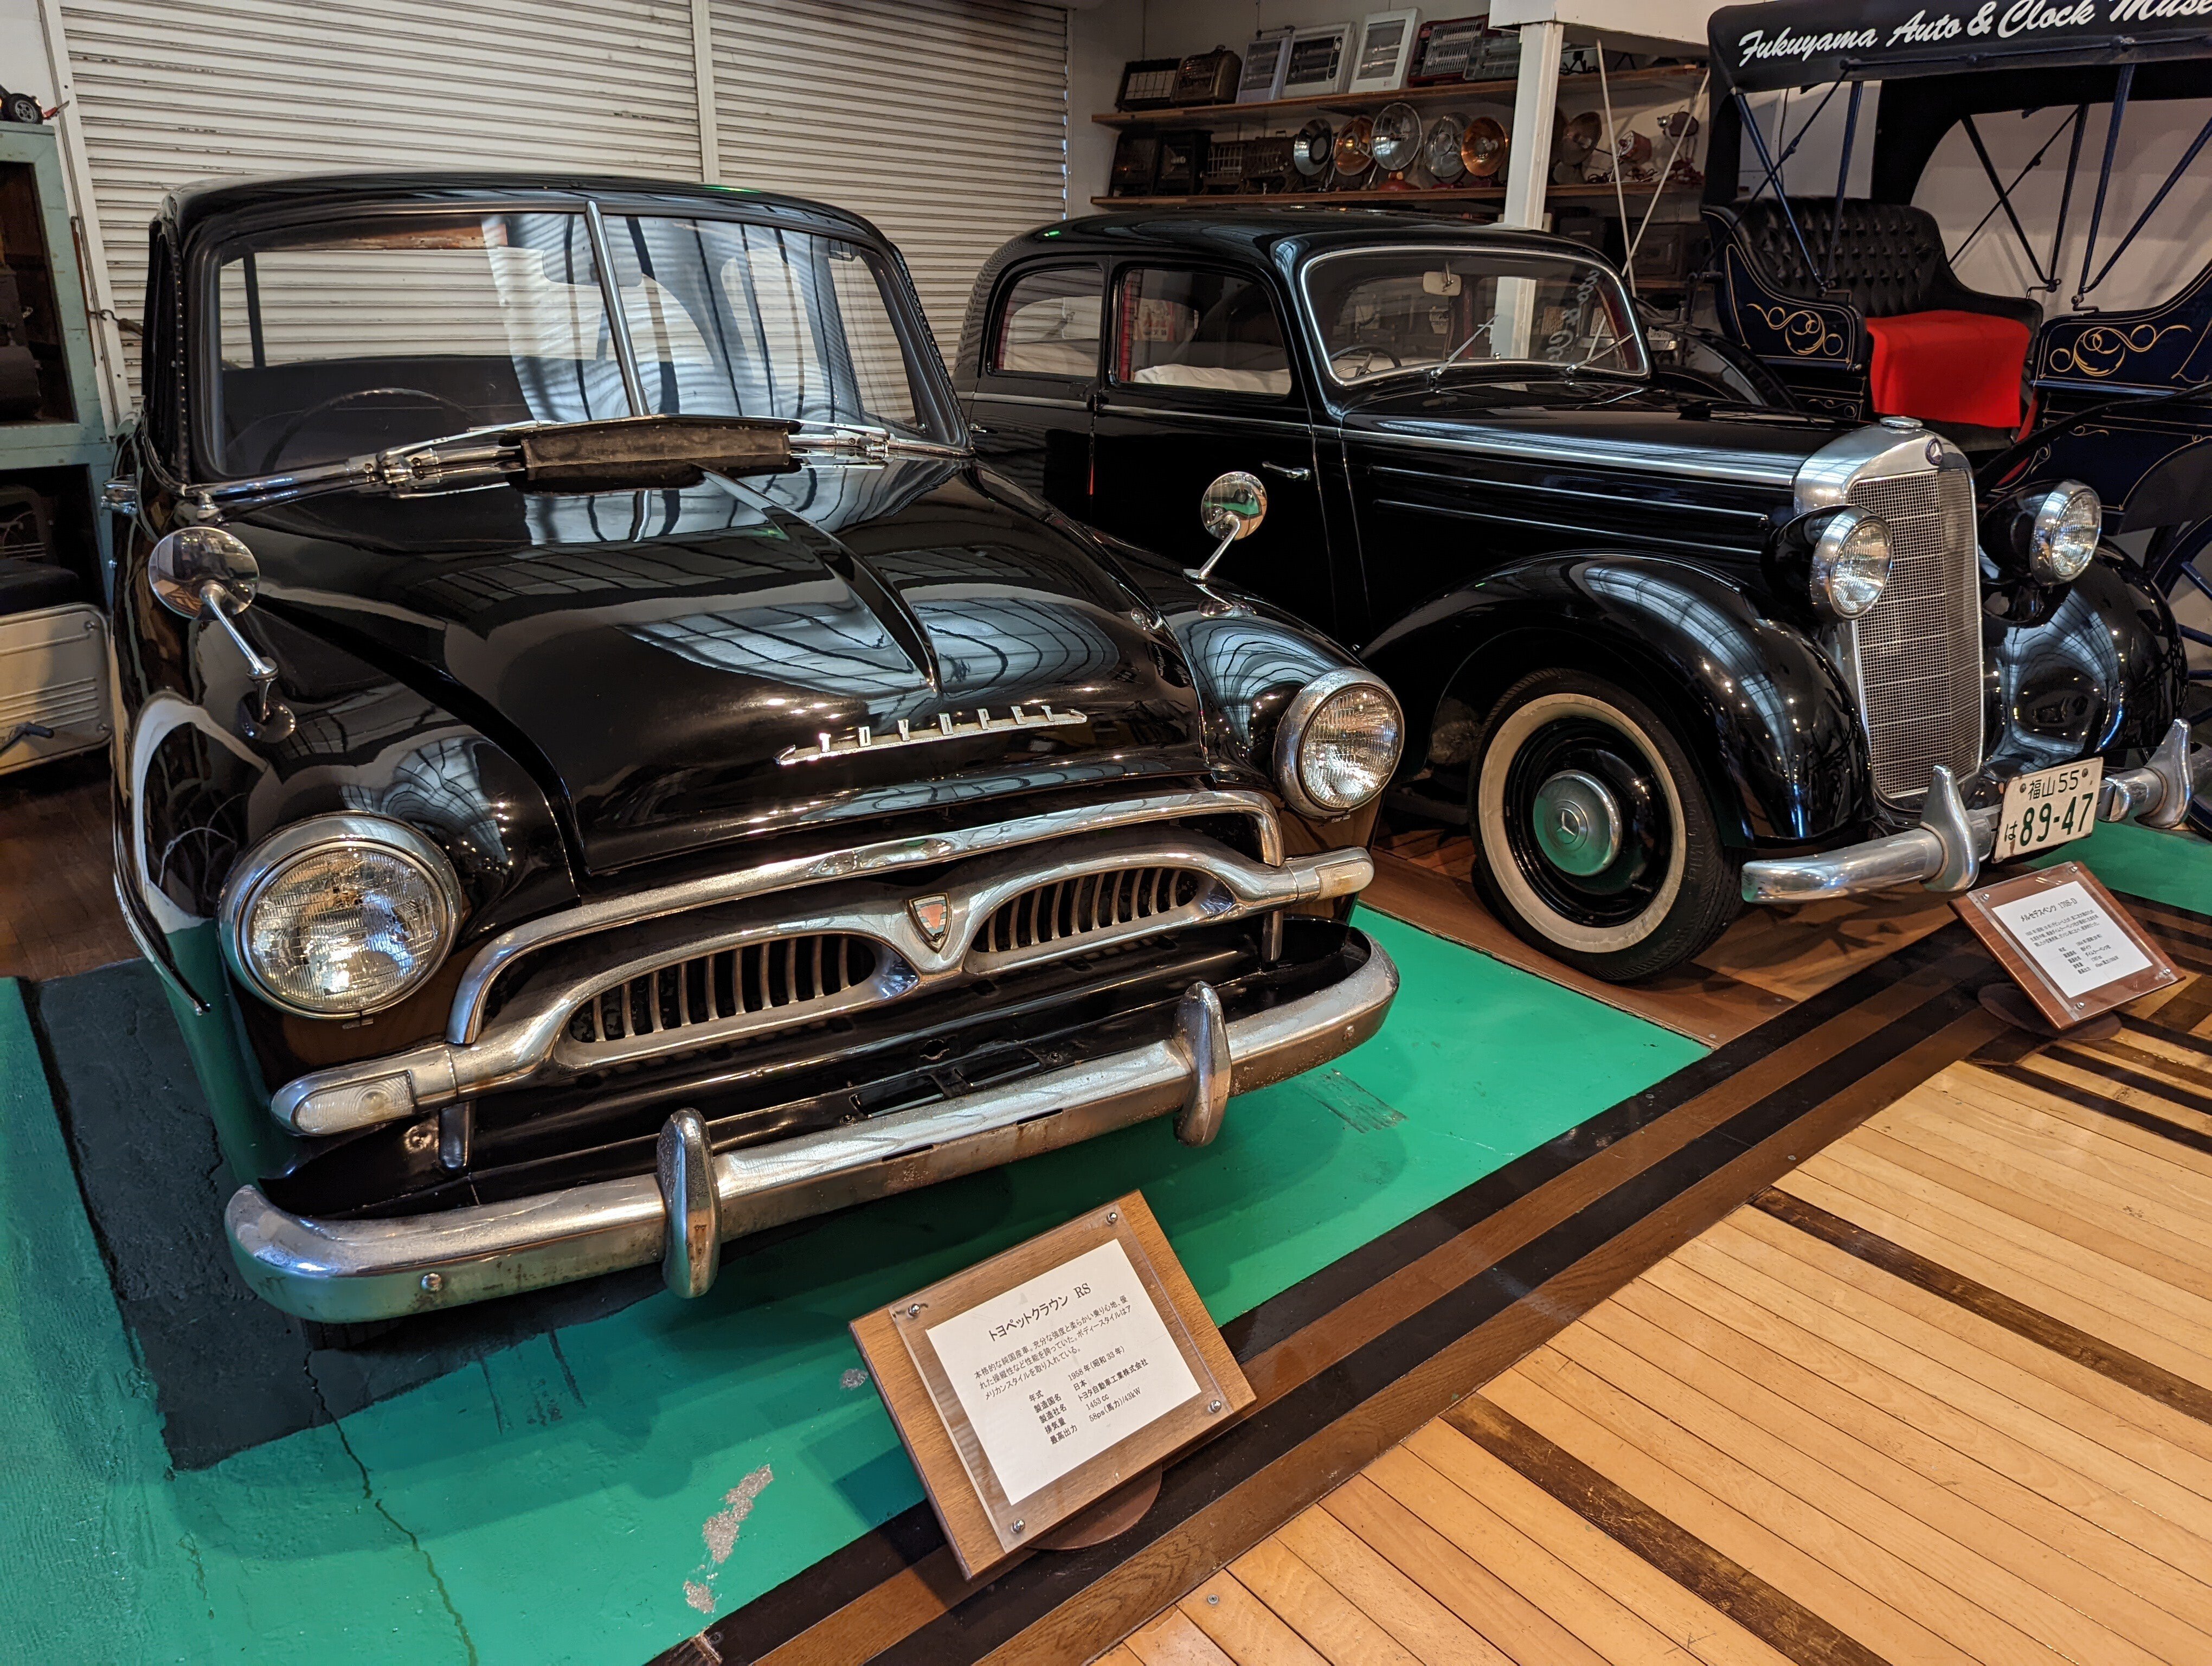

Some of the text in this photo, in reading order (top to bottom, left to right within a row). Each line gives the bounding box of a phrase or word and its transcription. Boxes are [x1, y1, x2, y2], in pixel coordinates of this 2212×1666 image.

[1738, 27, 1878, 67] Fukuyama
[1885, 10, 1963, 47] Auto
[1967, 1, 1997, 36] &
[1998, 0, 2095, 38] Clock
[818, 705, 1056, 753] TOYOPET
[2004, 792, 2094, 847] は 89-47
[989, 1283, 1091, 1341] トヨペットクラウン RS
[1030, 1390, 1044, 1401] 年式
[1034, 1380, 1087, 1413] 製造国名 日本
[1039, 1404, 1066, 1423] 製造社名
[1050, 1425, 1077, 1445] 最高出力
